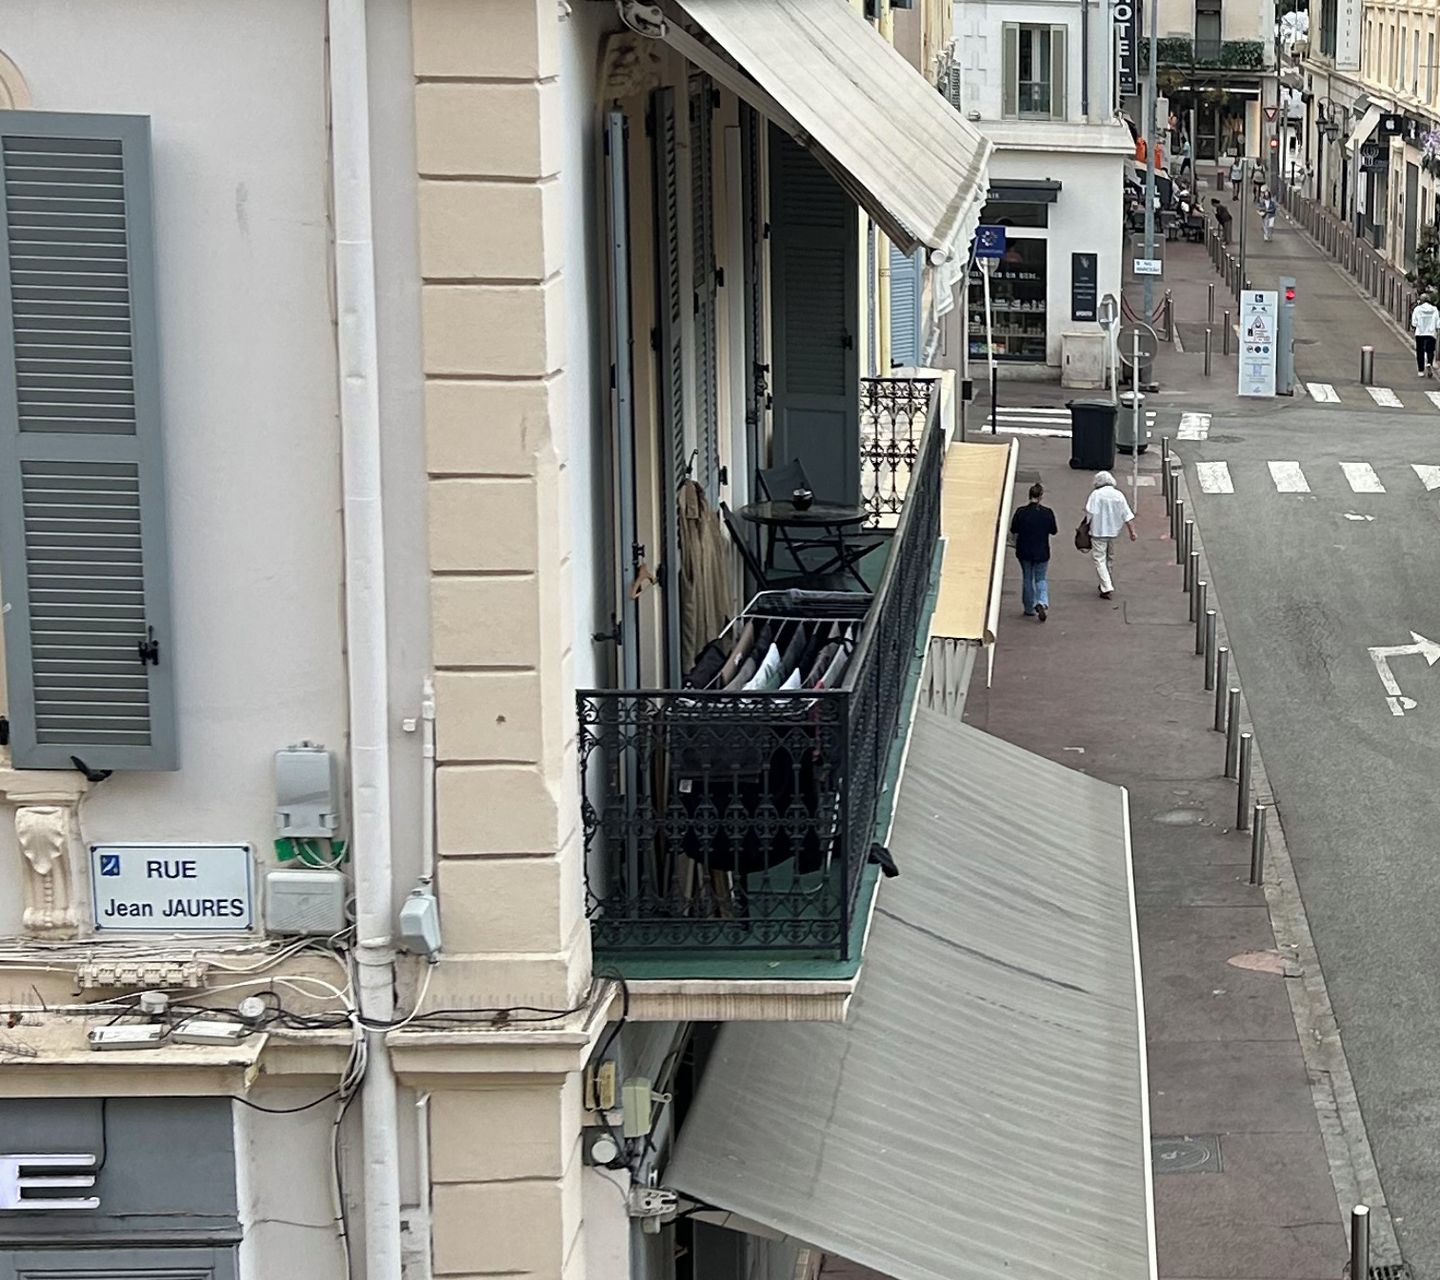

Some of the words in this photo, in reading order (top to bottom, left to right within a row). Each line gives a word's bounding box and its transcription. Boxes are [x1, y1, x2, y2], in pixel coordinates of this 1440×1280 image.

[146, 859, 197, 879] RUE
[104, 898, 153, 918] Jean
[162, 896, 245, 918] JAURES
